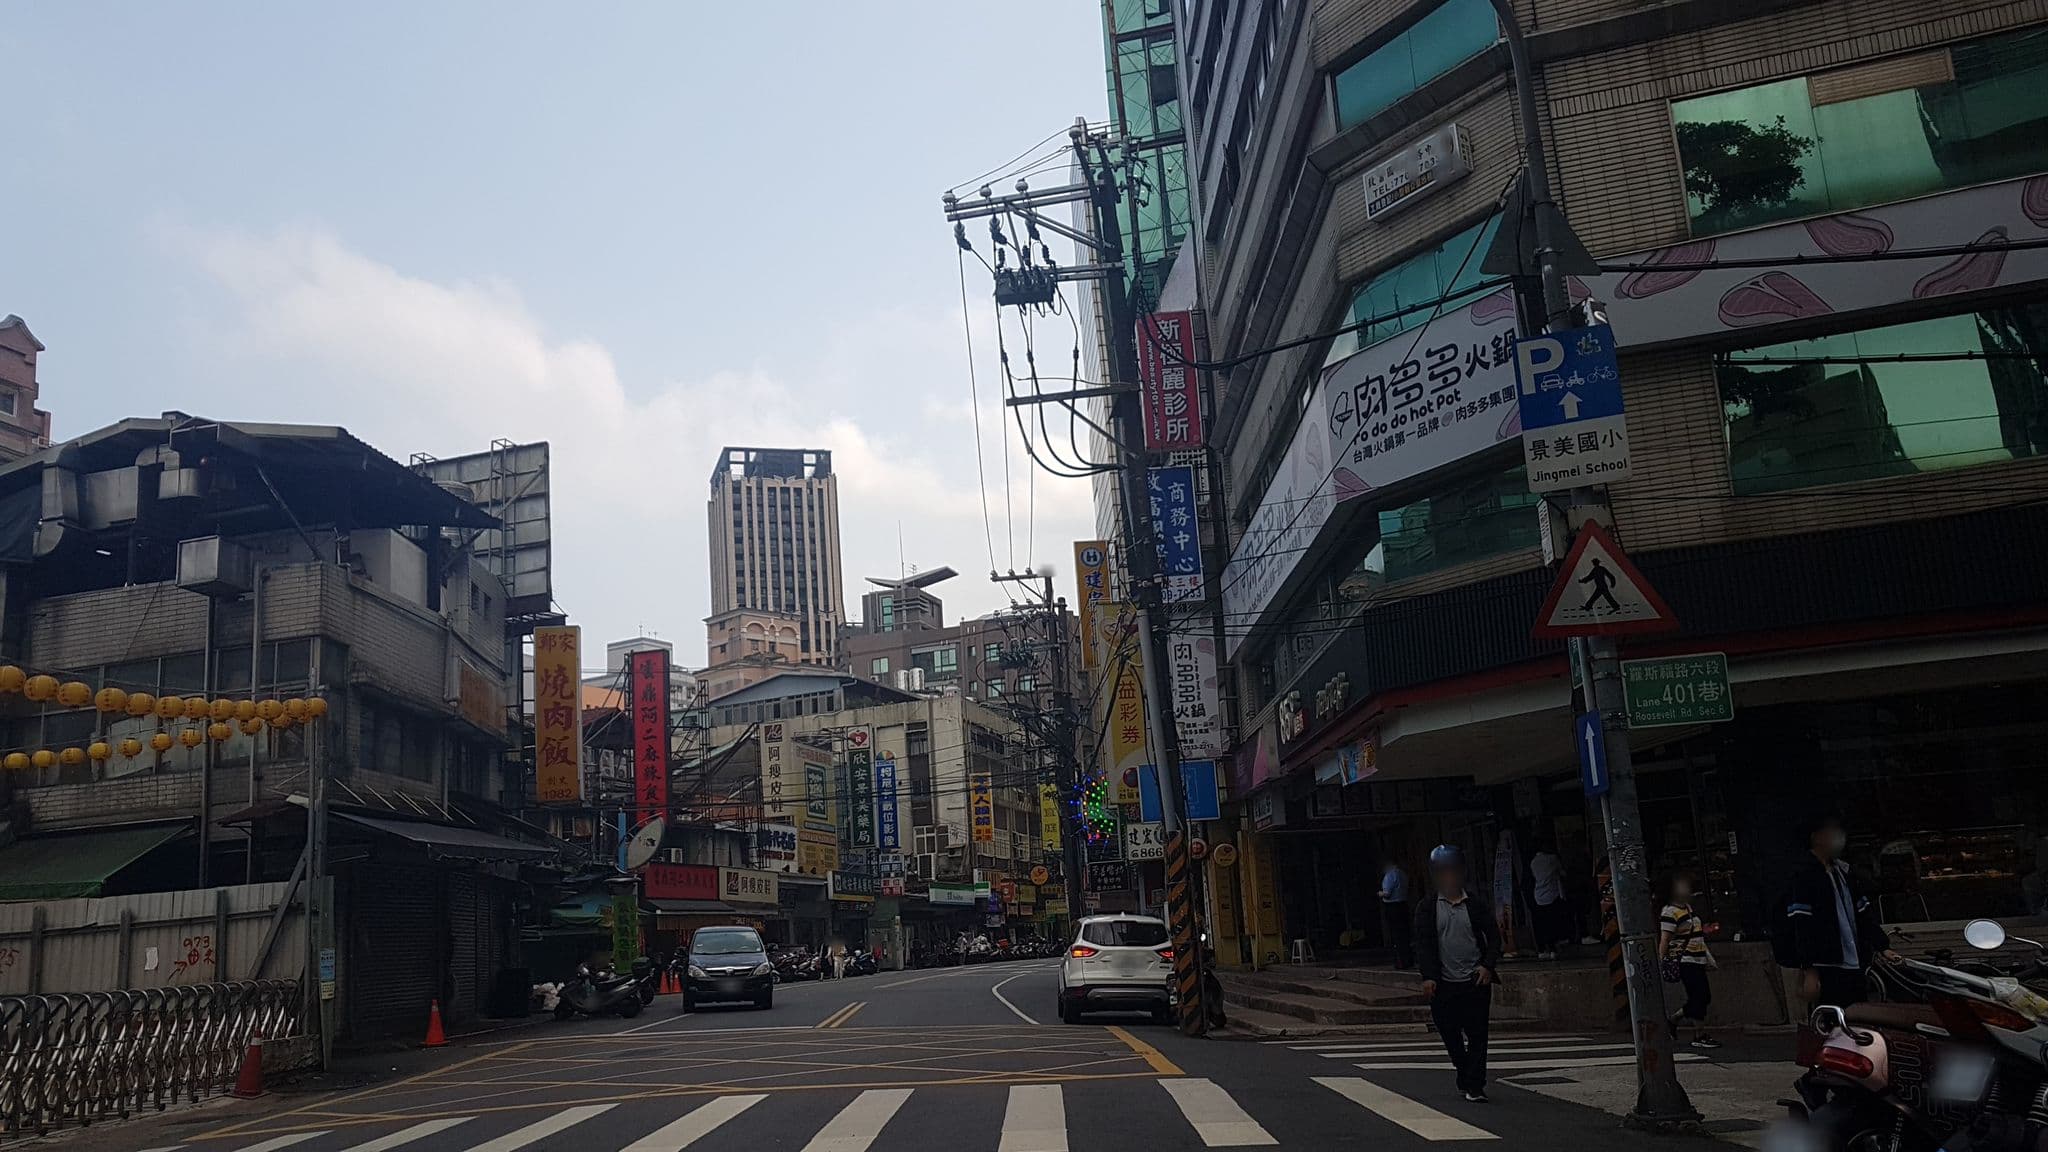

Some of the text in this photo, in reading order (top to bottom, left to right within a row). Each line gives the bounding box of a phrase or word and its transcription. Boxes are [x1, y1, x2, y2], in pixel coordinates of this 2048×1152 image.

[1516, 337, 1565, 395] P
[1372, 421, 1388, 437] do
[1391, 411, 1407, 430] do
[1410, 402, 1434, 420] hot
[1437, 389, 1461, 409] Pot
[1455, 385, 1516, 423] 肉多多集團
[1353, 417, 1440, 464] 台灣火鍋第一品牌
[1529, 429, 1623, 461] 景美國小
[1533, 458, 1628, 483] Jingmei School
[1167, 481, 1194, 573] 商務中心
[538, 633, 576, 653] 鄭家
[540, 664, 577, 768] 燒肉飯
[1636, 697, 1661, 709] Lane
[544, 788, 573, 800] 1982
[852, 753, 872, 844] 欣安景美藥局
[741, 876, 771, 895] 阿瘦皮鞋
